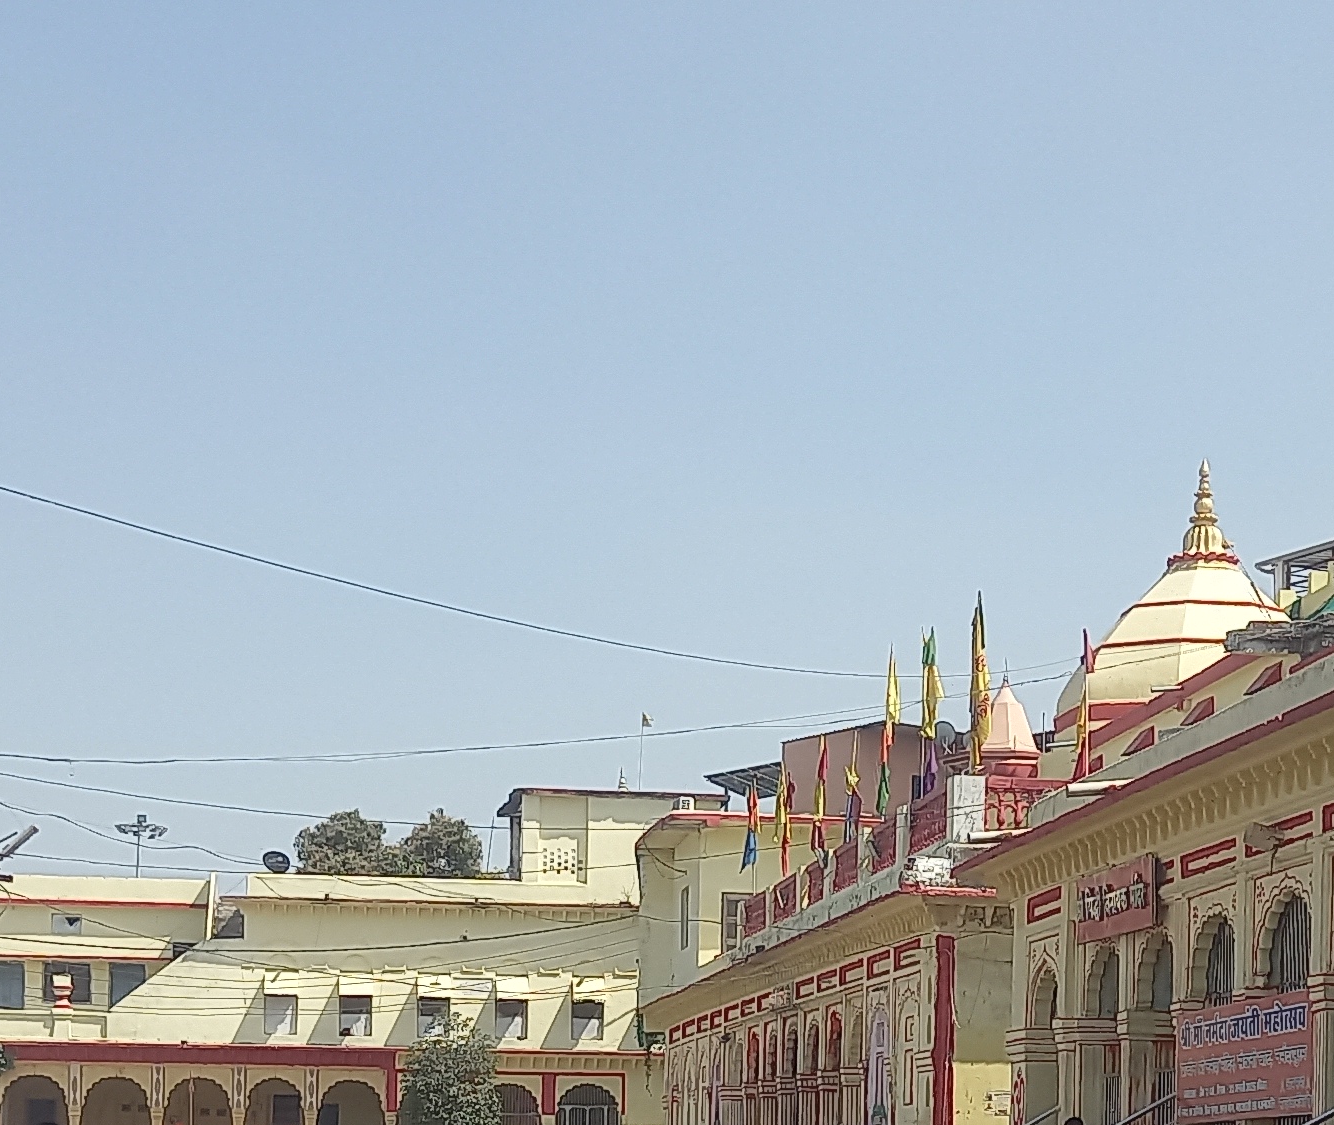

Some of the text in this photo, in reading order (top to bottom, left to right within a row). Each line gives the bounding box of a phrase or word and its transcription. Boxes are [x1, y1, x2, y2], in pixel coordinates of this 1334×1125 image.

[1180, 1019, 1191, 1049] श्री
[1204, 1012, 1228, 1046] नर्मदा
[1229, 1005, 1261, 1040] जयंती
[1262, 1001, 1308, 1035] महोत्सव
